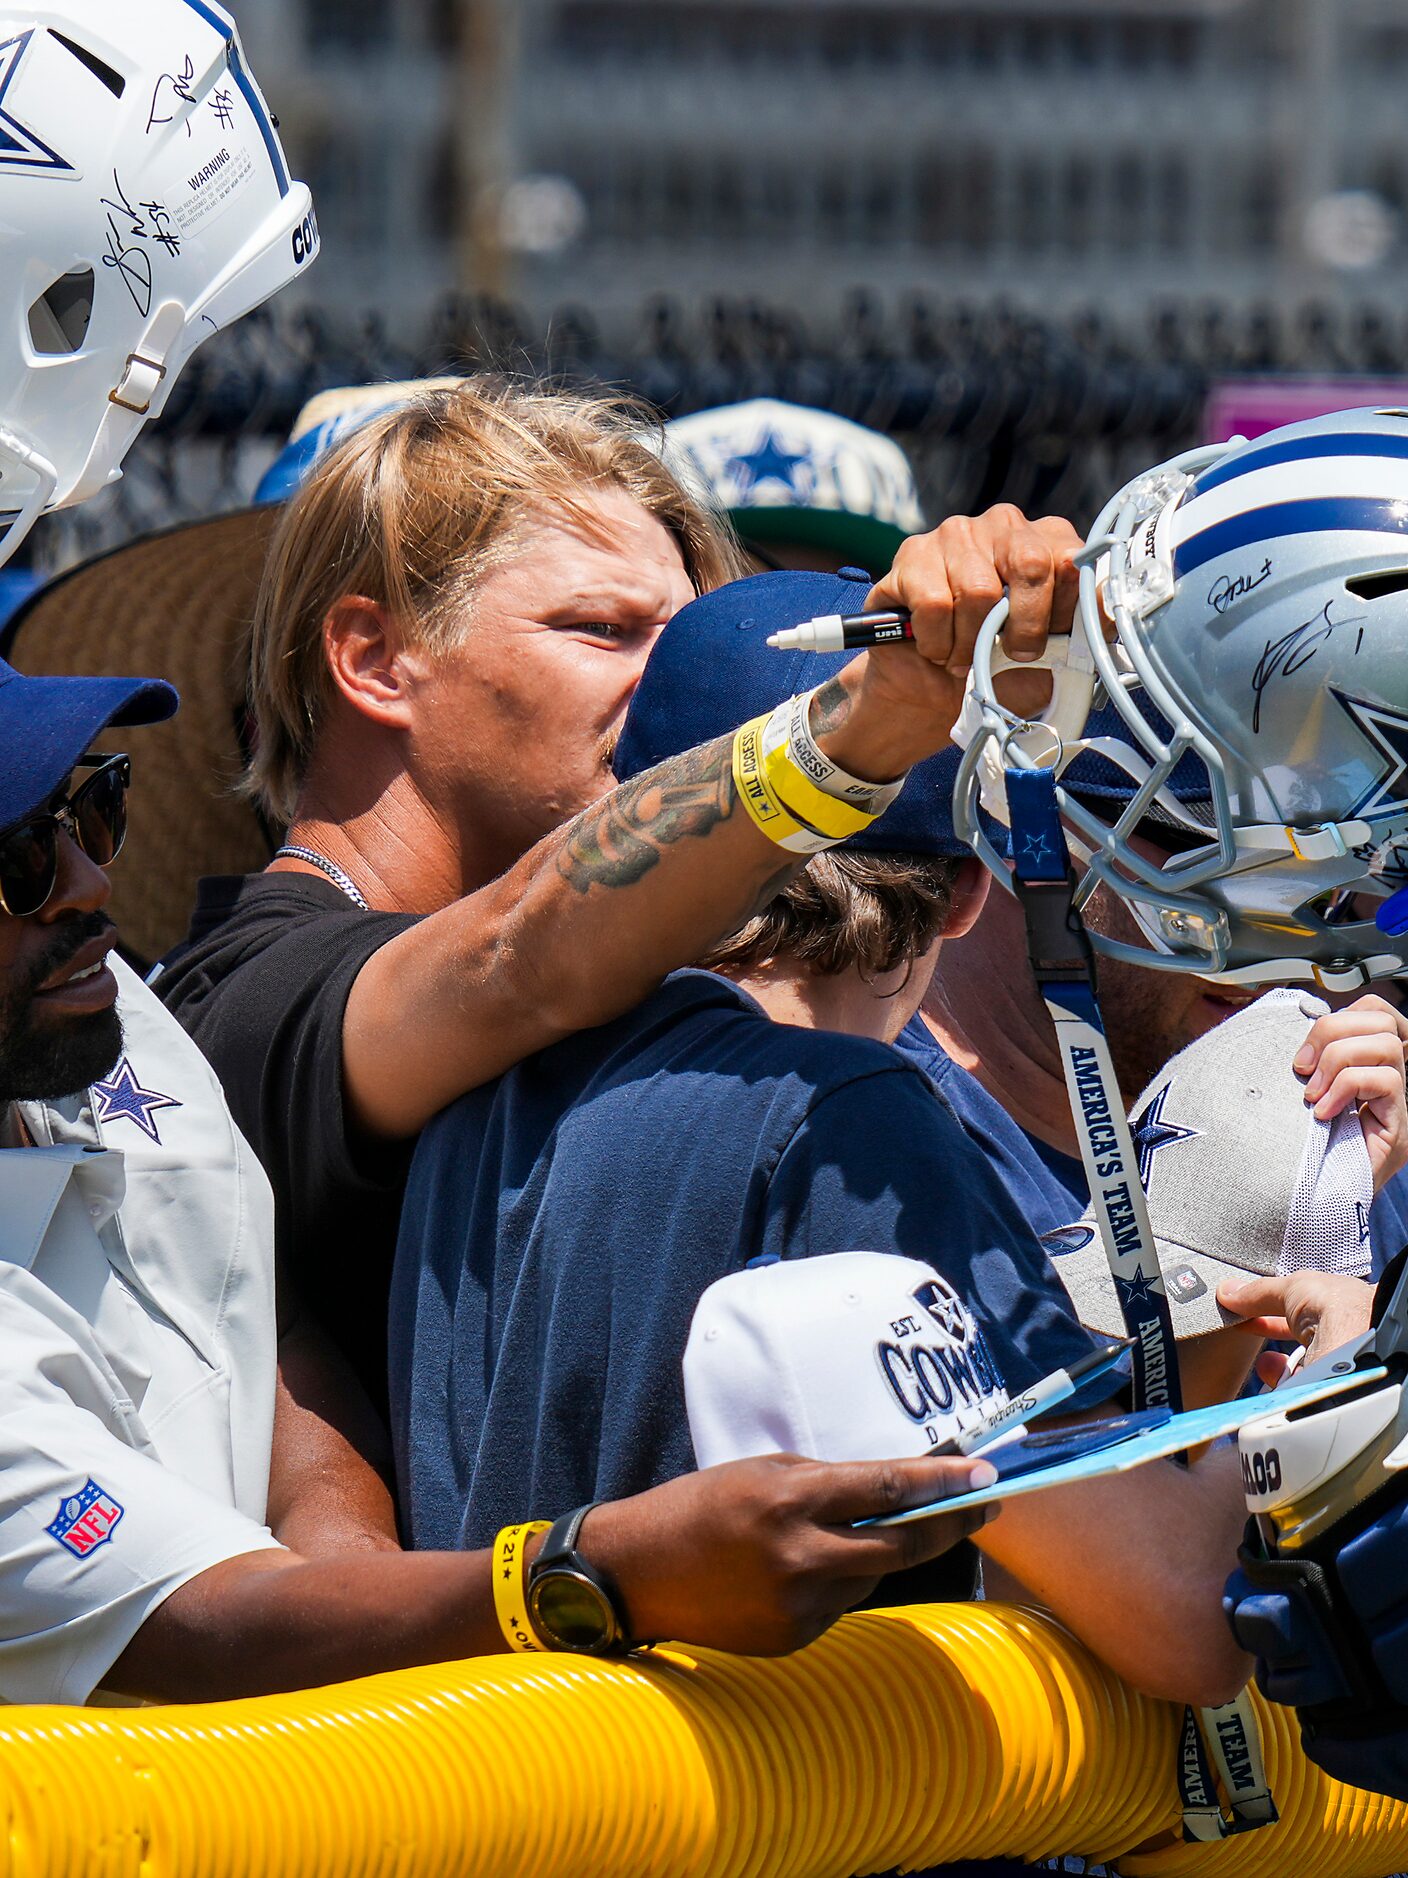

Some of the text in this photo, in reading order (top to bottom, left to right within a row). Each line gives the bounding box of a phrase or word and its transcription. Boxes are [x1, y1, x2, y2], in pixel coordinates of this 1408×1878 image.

[187, 148, 231, 191] WARNING
[180, 209, 205, 230] PROTECTIVE
[875, 626, 903, 638] uni
[742, 730, 765, 799] ALL ACCESS
[794, 737, 828, 779] ACCESS
[1069, 1045, 1143, 1257] AMERICA'S TEAM
[64, 1502, 119, 1553] NFL
[503, 1543, 515, 1563] 21
[1215, 1713, 1256, 1791] TEAM
